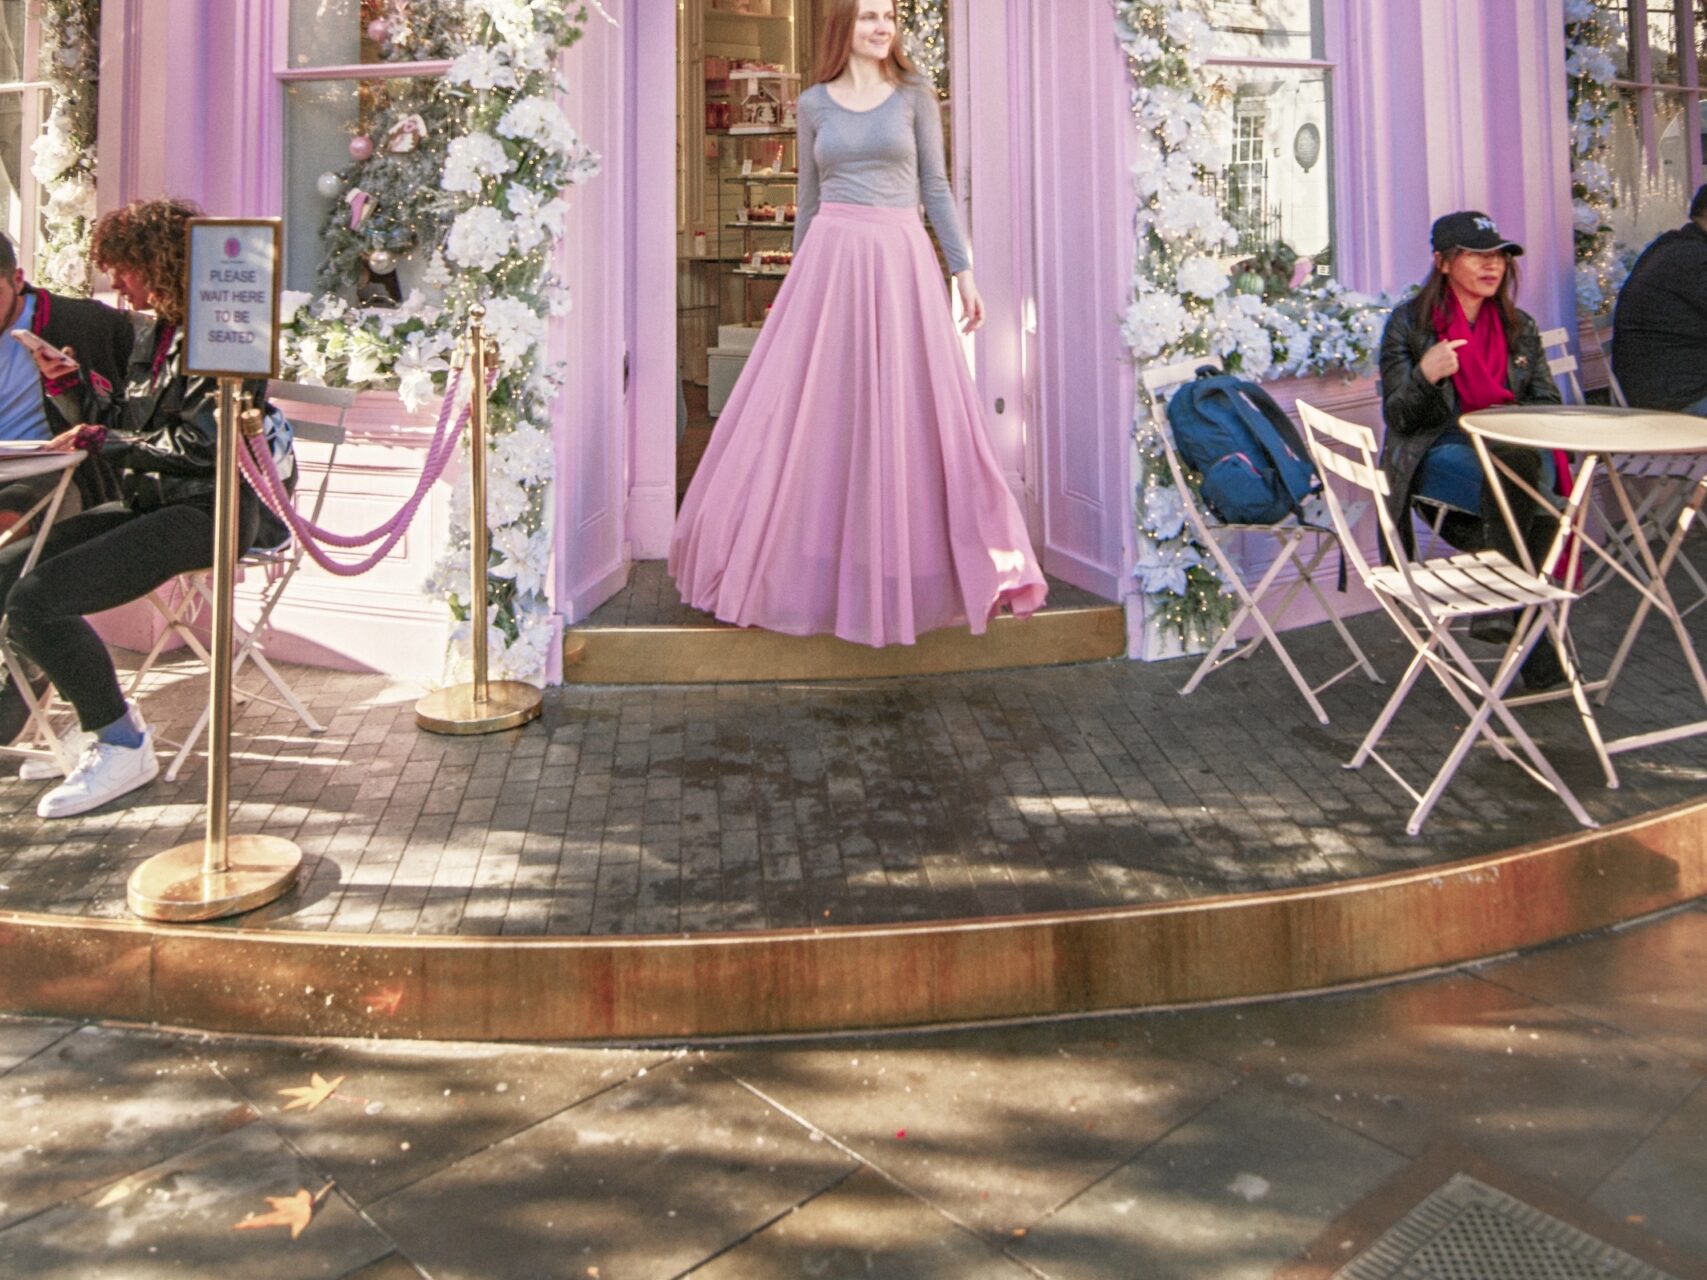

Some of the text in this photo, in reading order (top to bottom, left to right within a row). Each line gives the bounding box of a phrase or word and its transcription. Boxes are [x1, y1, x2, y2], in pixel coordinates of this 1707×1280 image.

[210, 269, 256, 283] PLEASE
[200, 290, 265, 303] WAIT HERE
[215, 310, 250, 323] TO BE
[208, 331, 255, 344] SEATED
